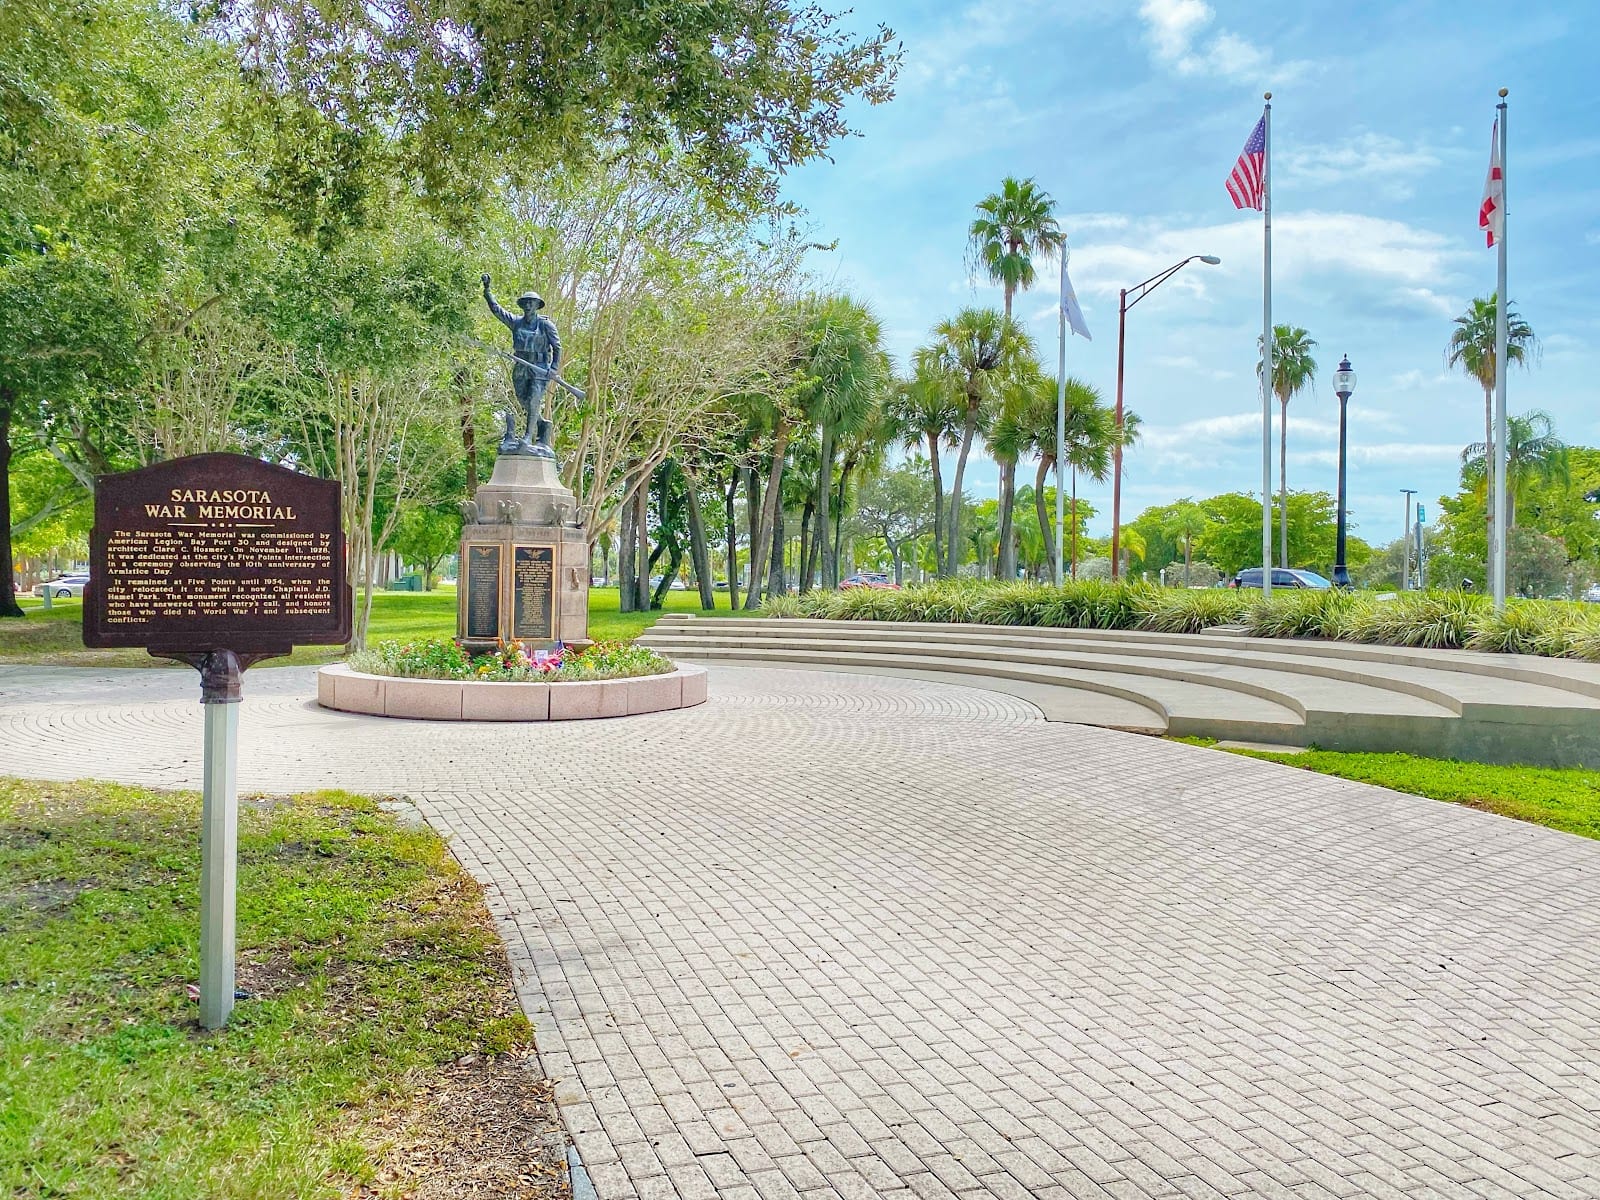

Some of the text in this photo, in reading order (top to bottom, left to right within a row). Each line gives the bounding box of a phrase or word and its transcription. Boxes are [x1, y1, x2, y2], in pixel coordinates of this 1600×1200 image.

[171, 489, 272, 504] SARASOTA
[144, 504, 297, 520] WAR MEMORIAL
[155, 538, 183, 546] Legion
[232, 593, 276, 601] recognizes
